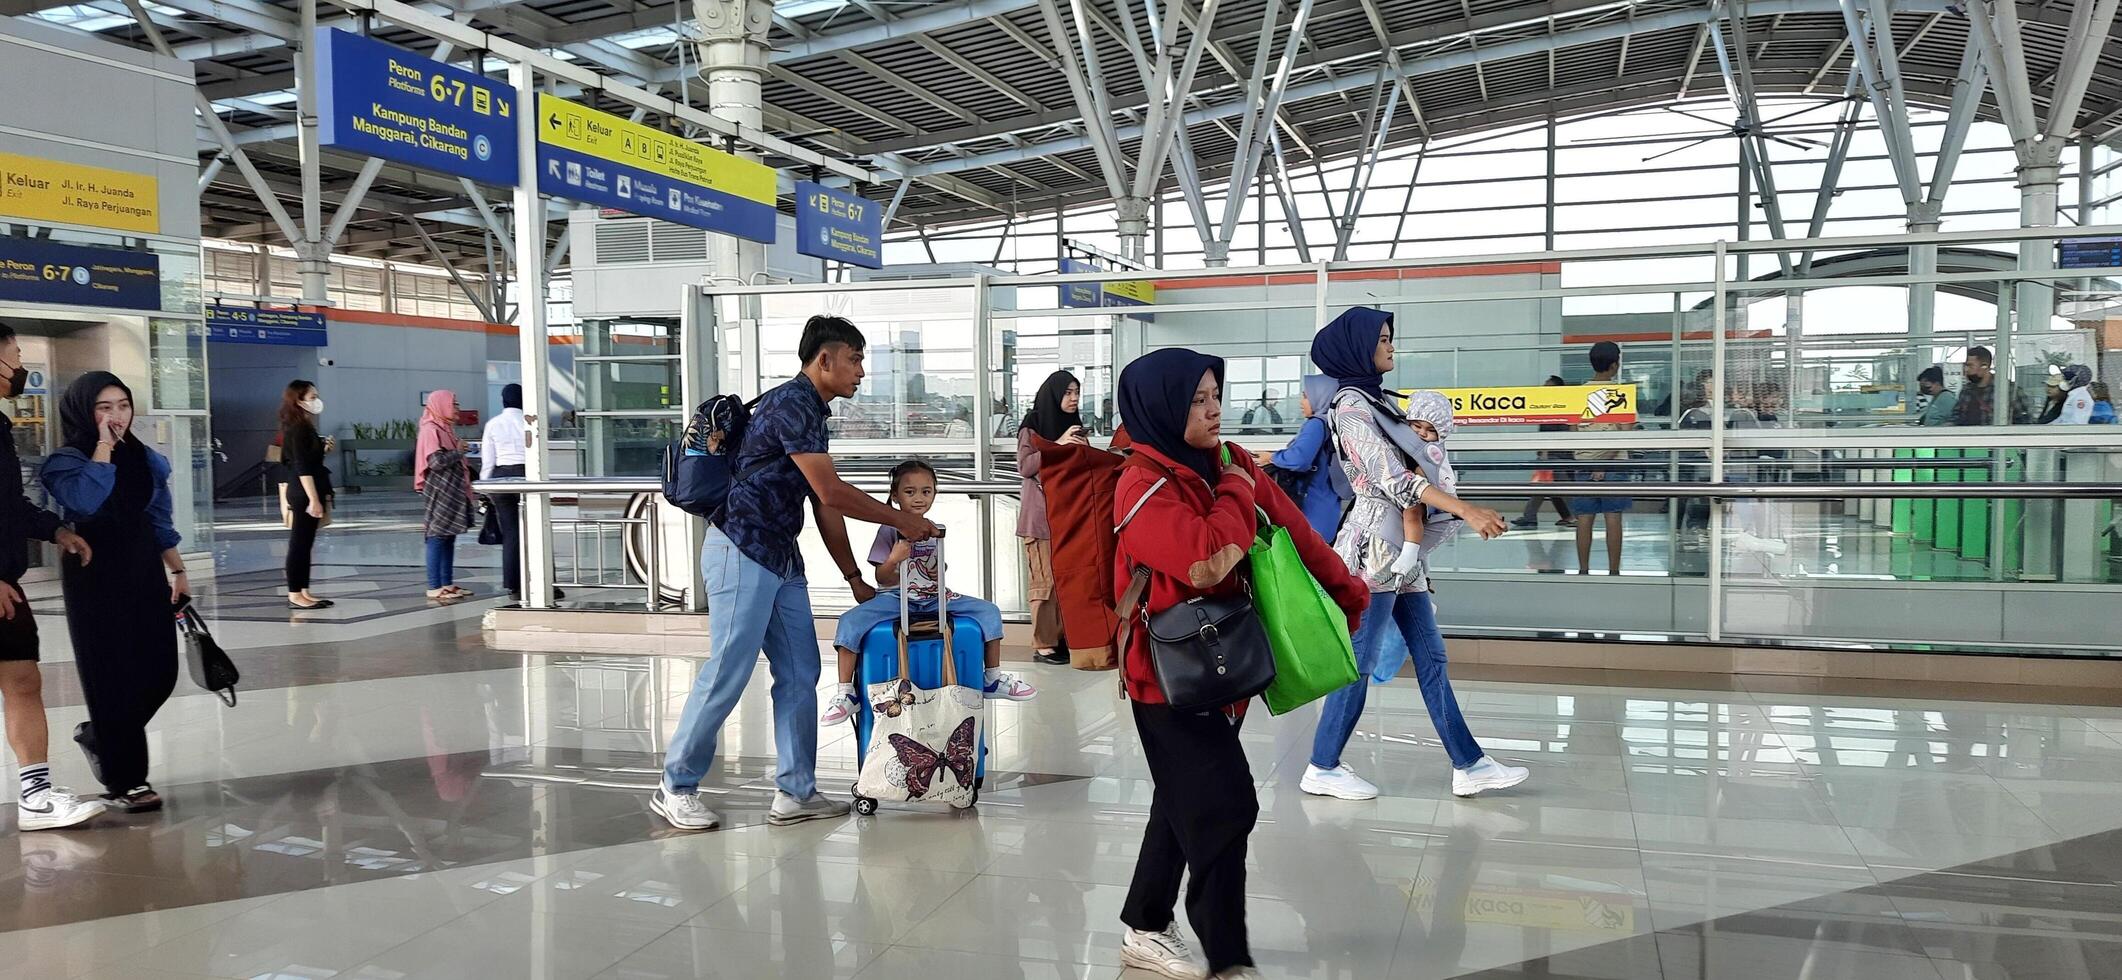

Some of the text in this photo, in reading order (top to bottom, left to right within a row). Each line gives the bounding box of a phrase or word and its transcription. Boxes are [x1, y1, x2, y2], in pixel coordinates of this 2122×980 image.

[389, 59, 422, 81] Peron
[388, 78, 425, 96] Platforms
[372, 103, 468, 140] Kampung Bandan
[586, 120, 612, 136] Keluar
[353, 115, 418, 148] Manggarai,
[420, 134, 468, 160] Cikarang
[586, 135, 598, 144] Exit
[625, 138, 632, 149] A
[6, 172, 50, 190] Keluar
[61, 180, 74, 190] Jl.
[88, 183, 98, 193] H.
[100, 185, 134, 198] Juanda
[6, 188, 22, 199] Exit
[62, 196, 152, 217] Jl. Raya Perjuangan
[6, 260, 36, 271] Peron
[1470, 394, 1526, 410] Kaca
